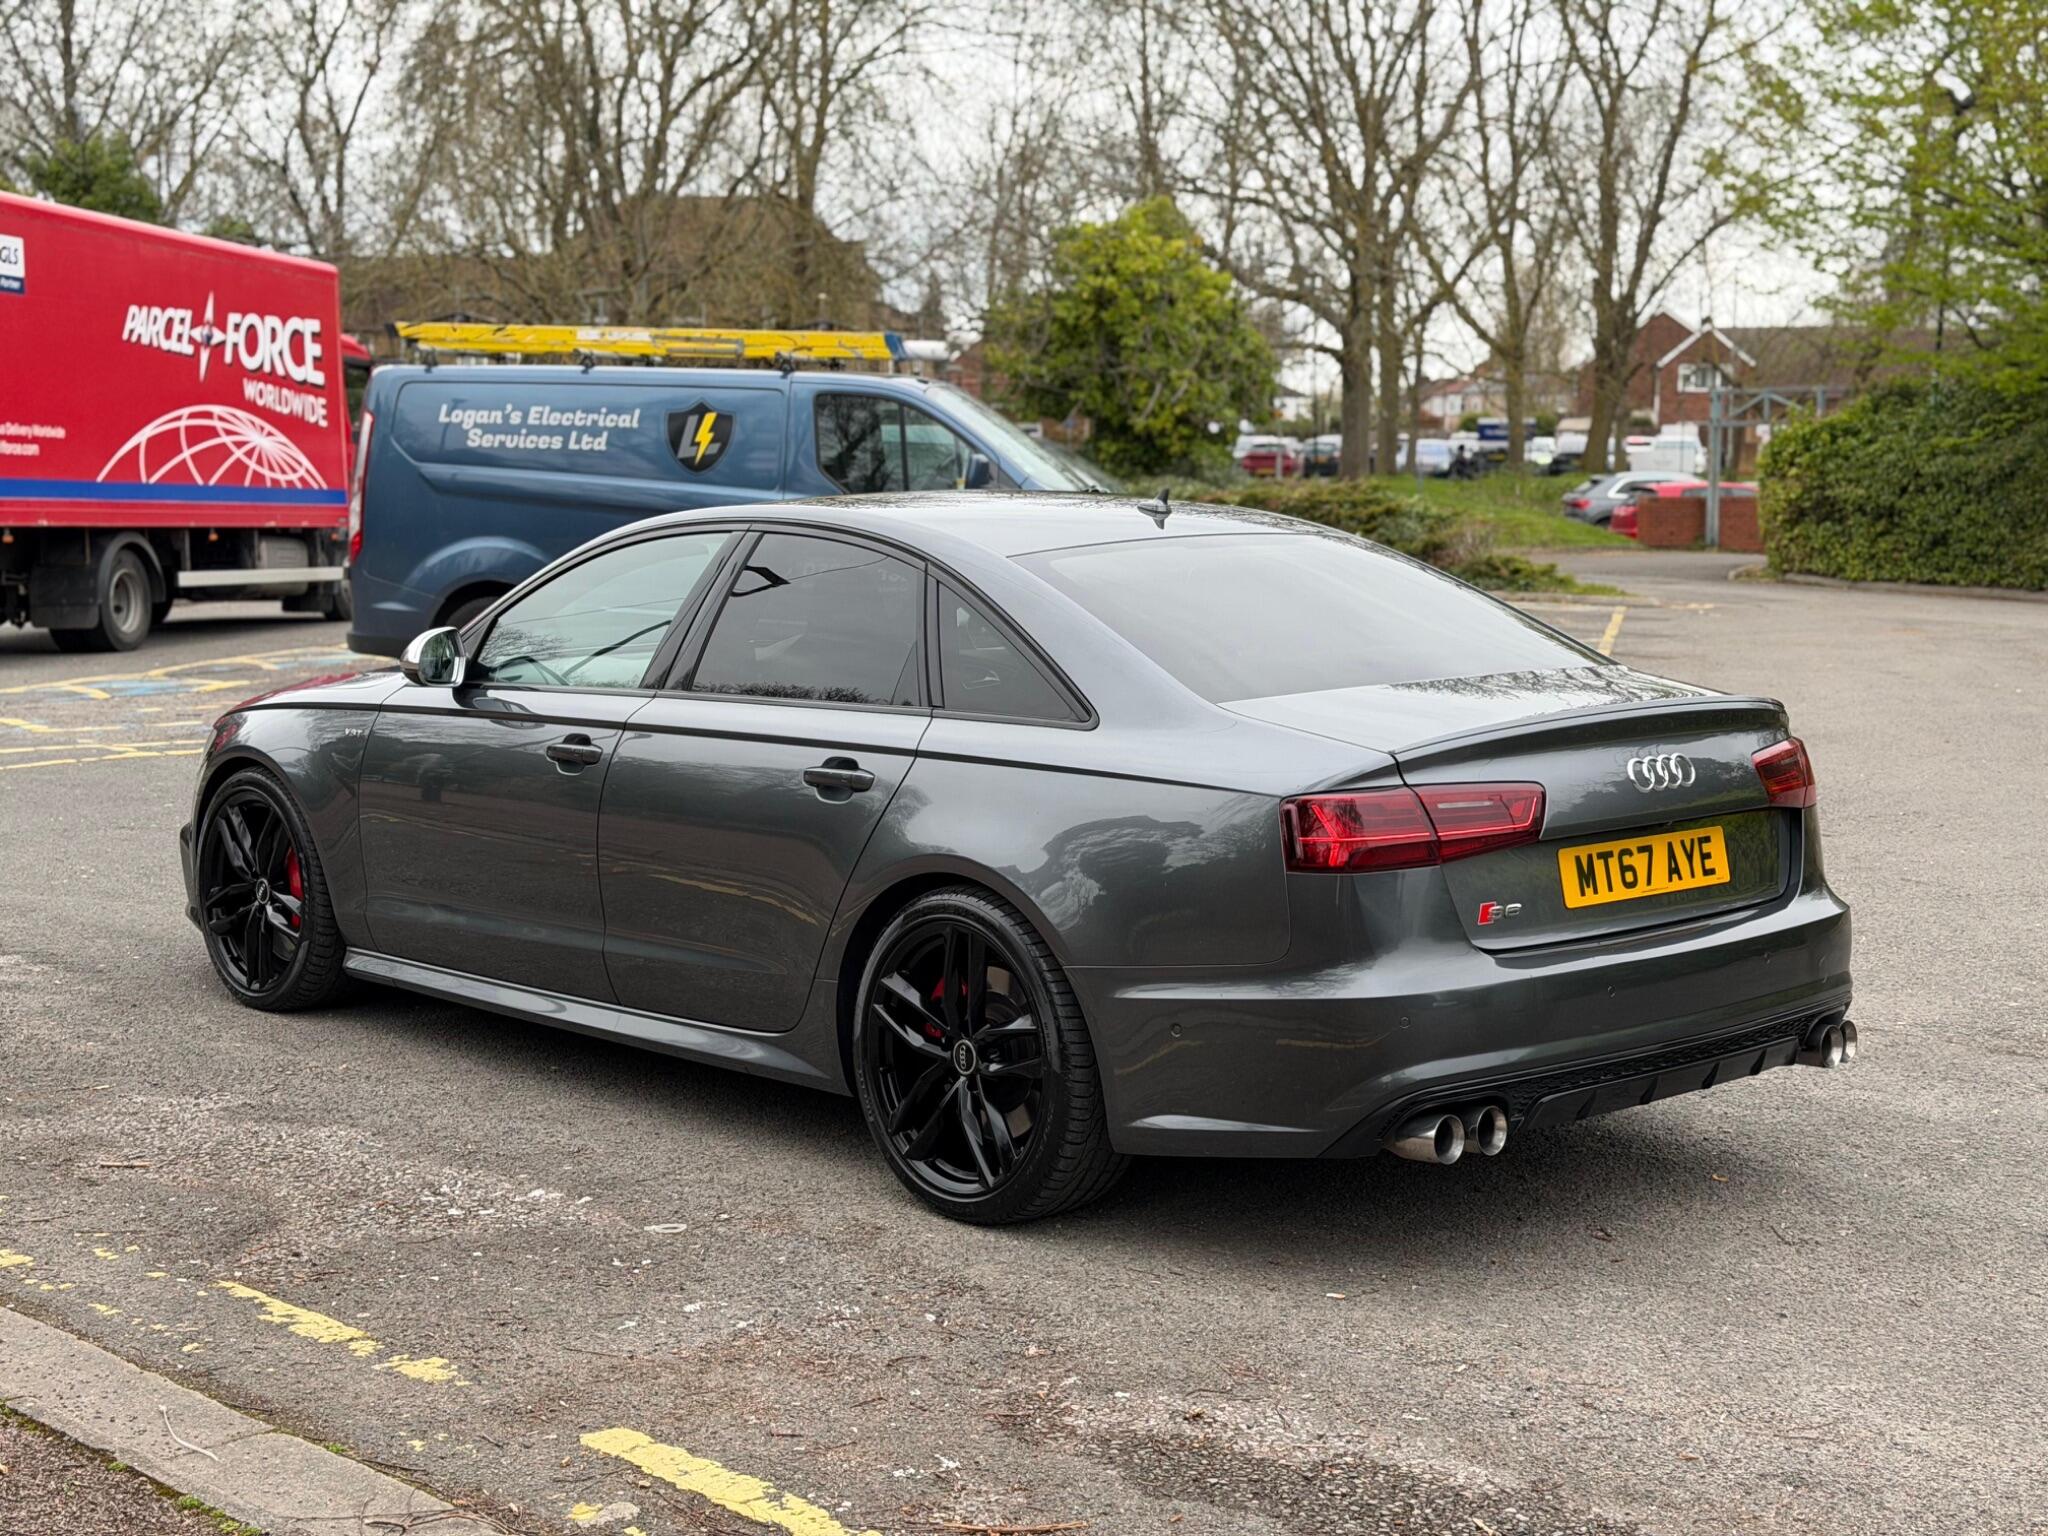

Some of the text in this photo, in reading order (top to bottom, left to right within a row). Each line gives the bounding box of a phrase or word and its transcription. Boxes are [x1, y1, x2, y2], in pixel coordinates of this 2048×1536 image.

[122, 304, 325, 386] PARCEL FORCE
[243, 378, 328, 428] WORLDWIDE
[438, 403, 641, 430] Logan's Electrical
[466, 428, 608, 450] Services Ltd
[1574, 835, 1717, 897] MT67 AYE
[1486, 903, 1522, 921] S6
